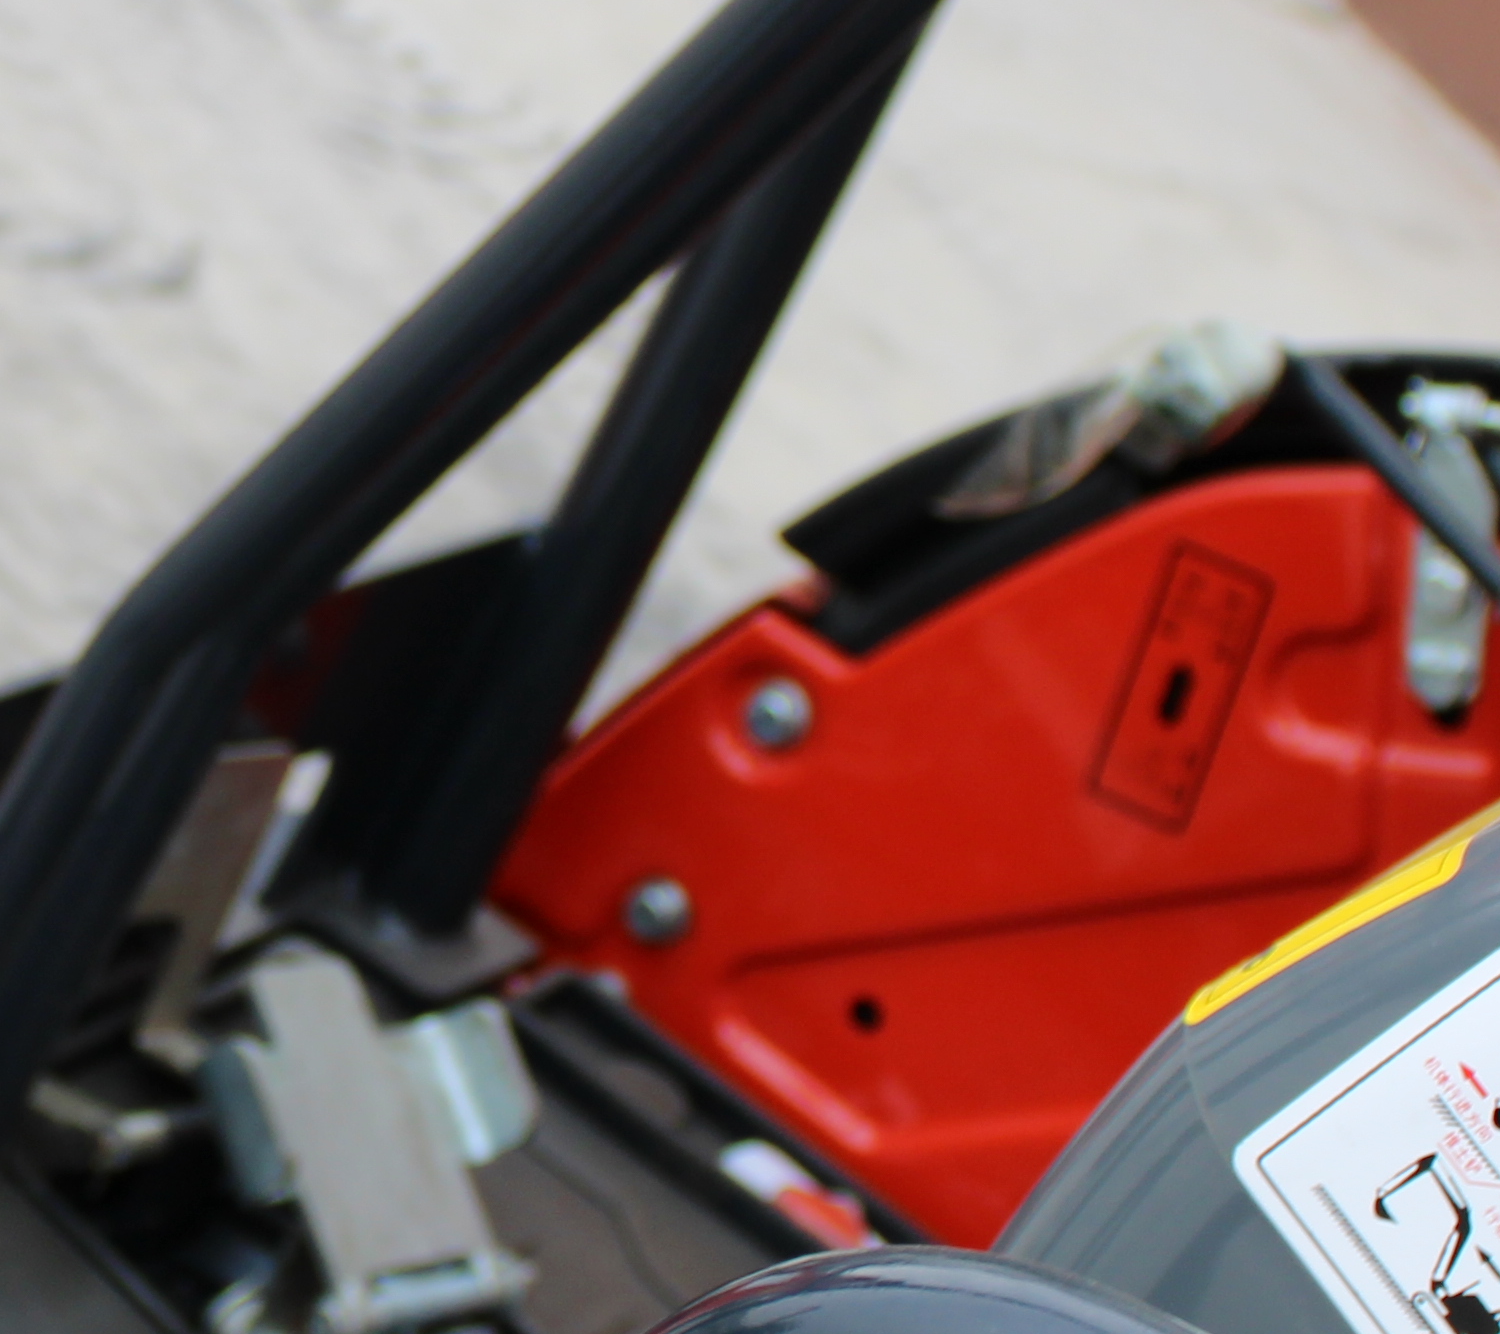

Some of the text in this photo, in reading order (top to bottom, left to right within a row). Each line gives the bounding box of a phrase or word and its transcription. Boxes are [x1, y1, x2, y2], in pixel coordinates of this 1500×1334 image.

[1419, 1053, 1497, 1146] 机体行进方向
